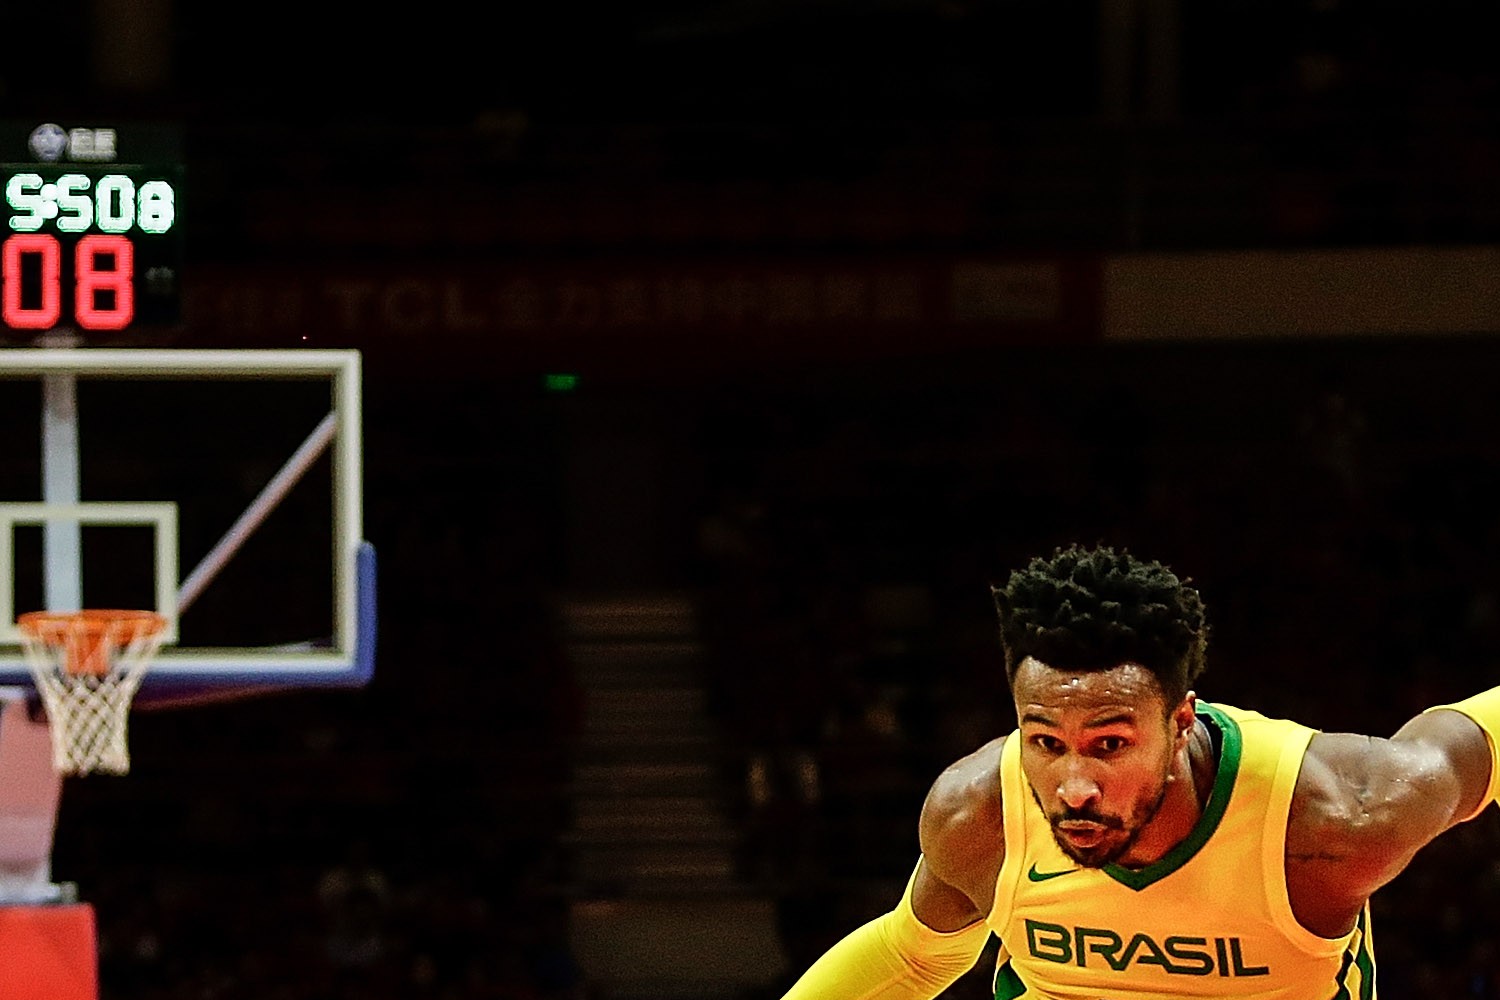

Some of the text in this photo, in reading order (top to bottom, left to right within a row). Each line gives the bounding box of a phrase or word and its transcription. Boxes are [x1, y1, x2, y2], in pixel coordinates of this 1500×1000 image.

[2, 233, 134, 330] 08
[323, 277, 487, 331] TCL
[1024, 919, 1269, 977] BRASIL
